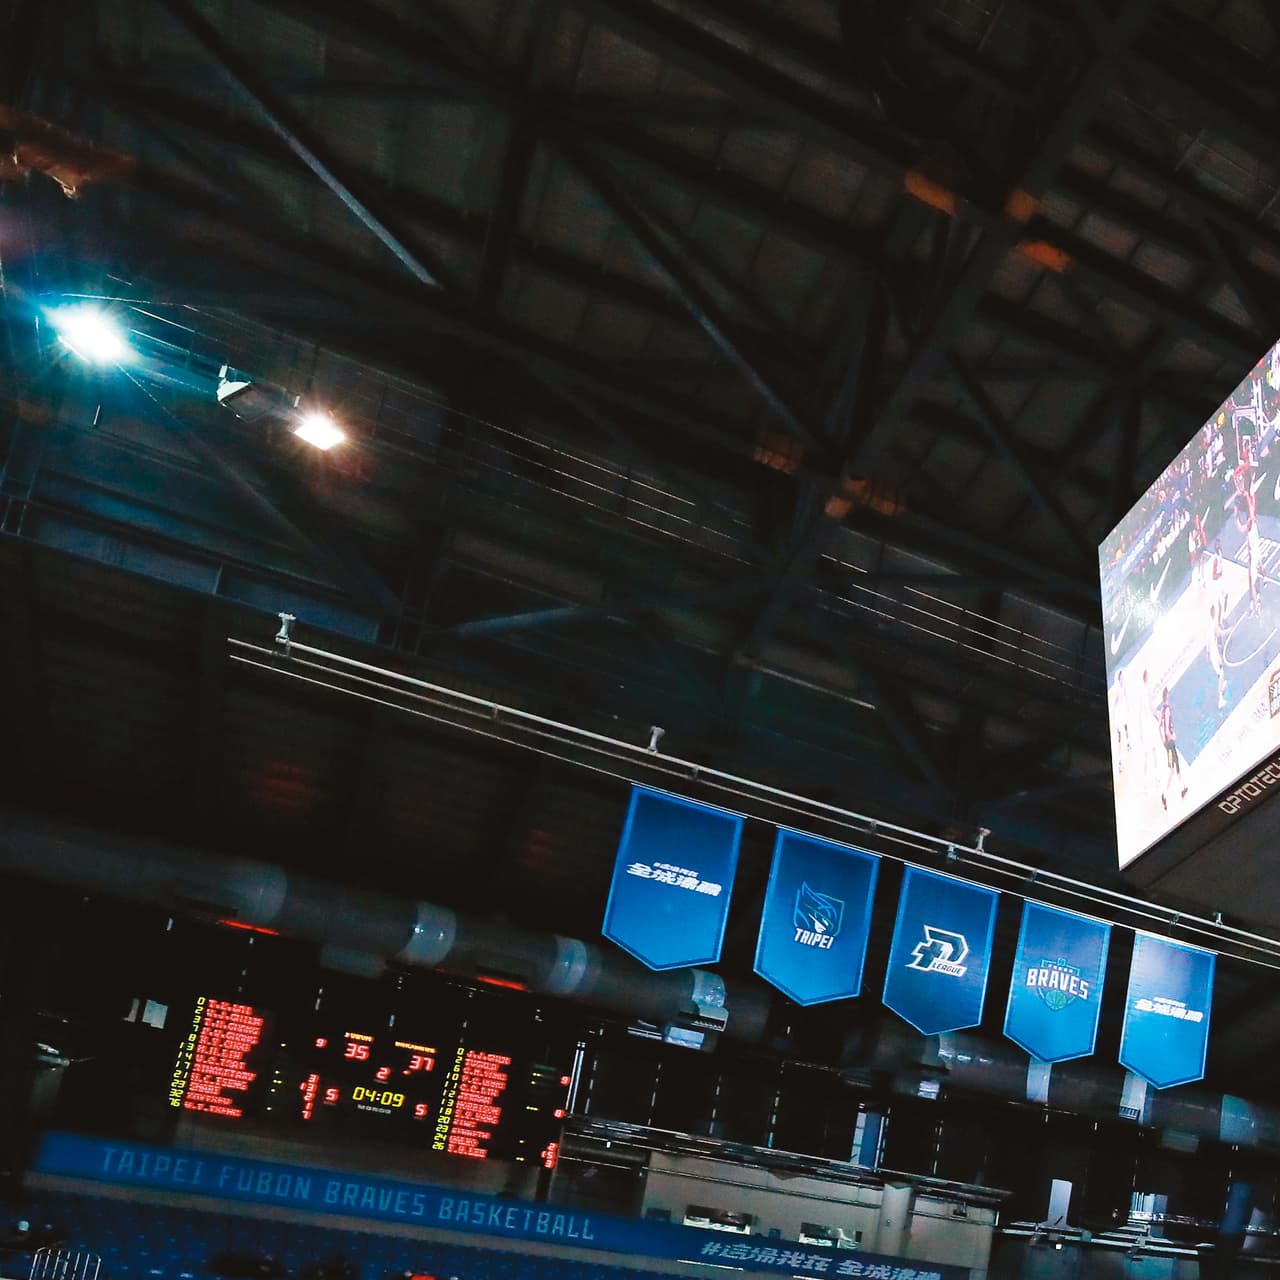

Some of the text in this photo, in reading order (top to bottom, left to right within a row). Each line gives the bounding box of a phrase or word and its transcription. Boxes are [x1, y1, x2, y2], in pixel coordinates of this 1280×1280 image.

[793, 927, 835, 950] TAIPEI
[931, 961, 963, 975] LEAGUE
[1026, 968, 1089, 1001] BRAVES
[344, 1042, 370, 1060] 35
[409, 1054, 435, 1072] 37
[375, 1066, 391, 1081] 2
[325, 1088, 339, 1102] 5
[352, 1086, 405, 1108] 04:09
[415, 1103, 428, 1117] 5
[103, 1147, 595, 1242] TAIPEI FUBON BRAVES BASKETBALL
